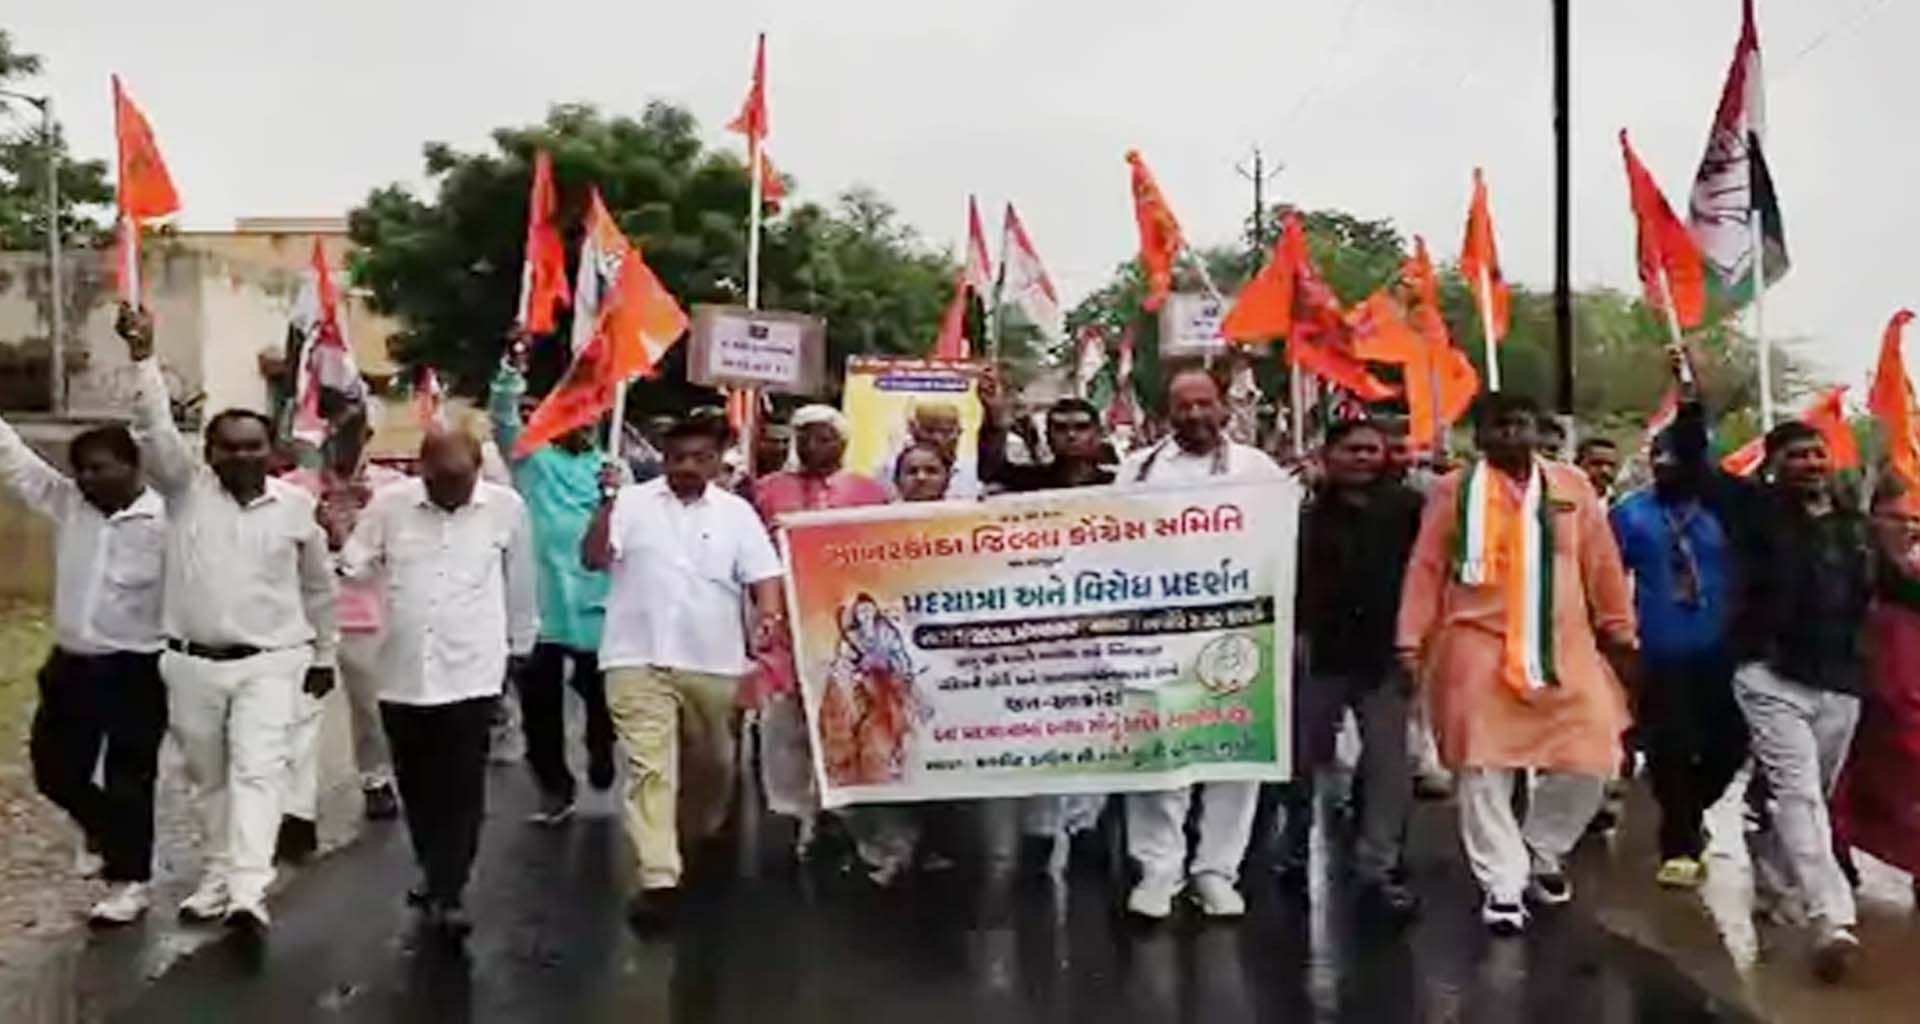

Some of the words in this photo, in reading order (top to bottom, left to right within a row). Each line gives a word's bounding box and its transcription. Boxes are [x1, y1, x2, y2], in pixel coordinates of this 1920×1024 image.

[972, 524, 1060, 553] જિલ્લા
[1069, 514, 1147, 546] કોંગ્રેસ
[1154, 504, 1244, 537] સમિતિ
[902, 586, 1006, 614] પદયાત્રા
[1014, 574, 1067, 608] અને
[1075, 570, 1152, 605] વિરોધ
[1159, 557, 1250, 598] પ્રદર્શન
